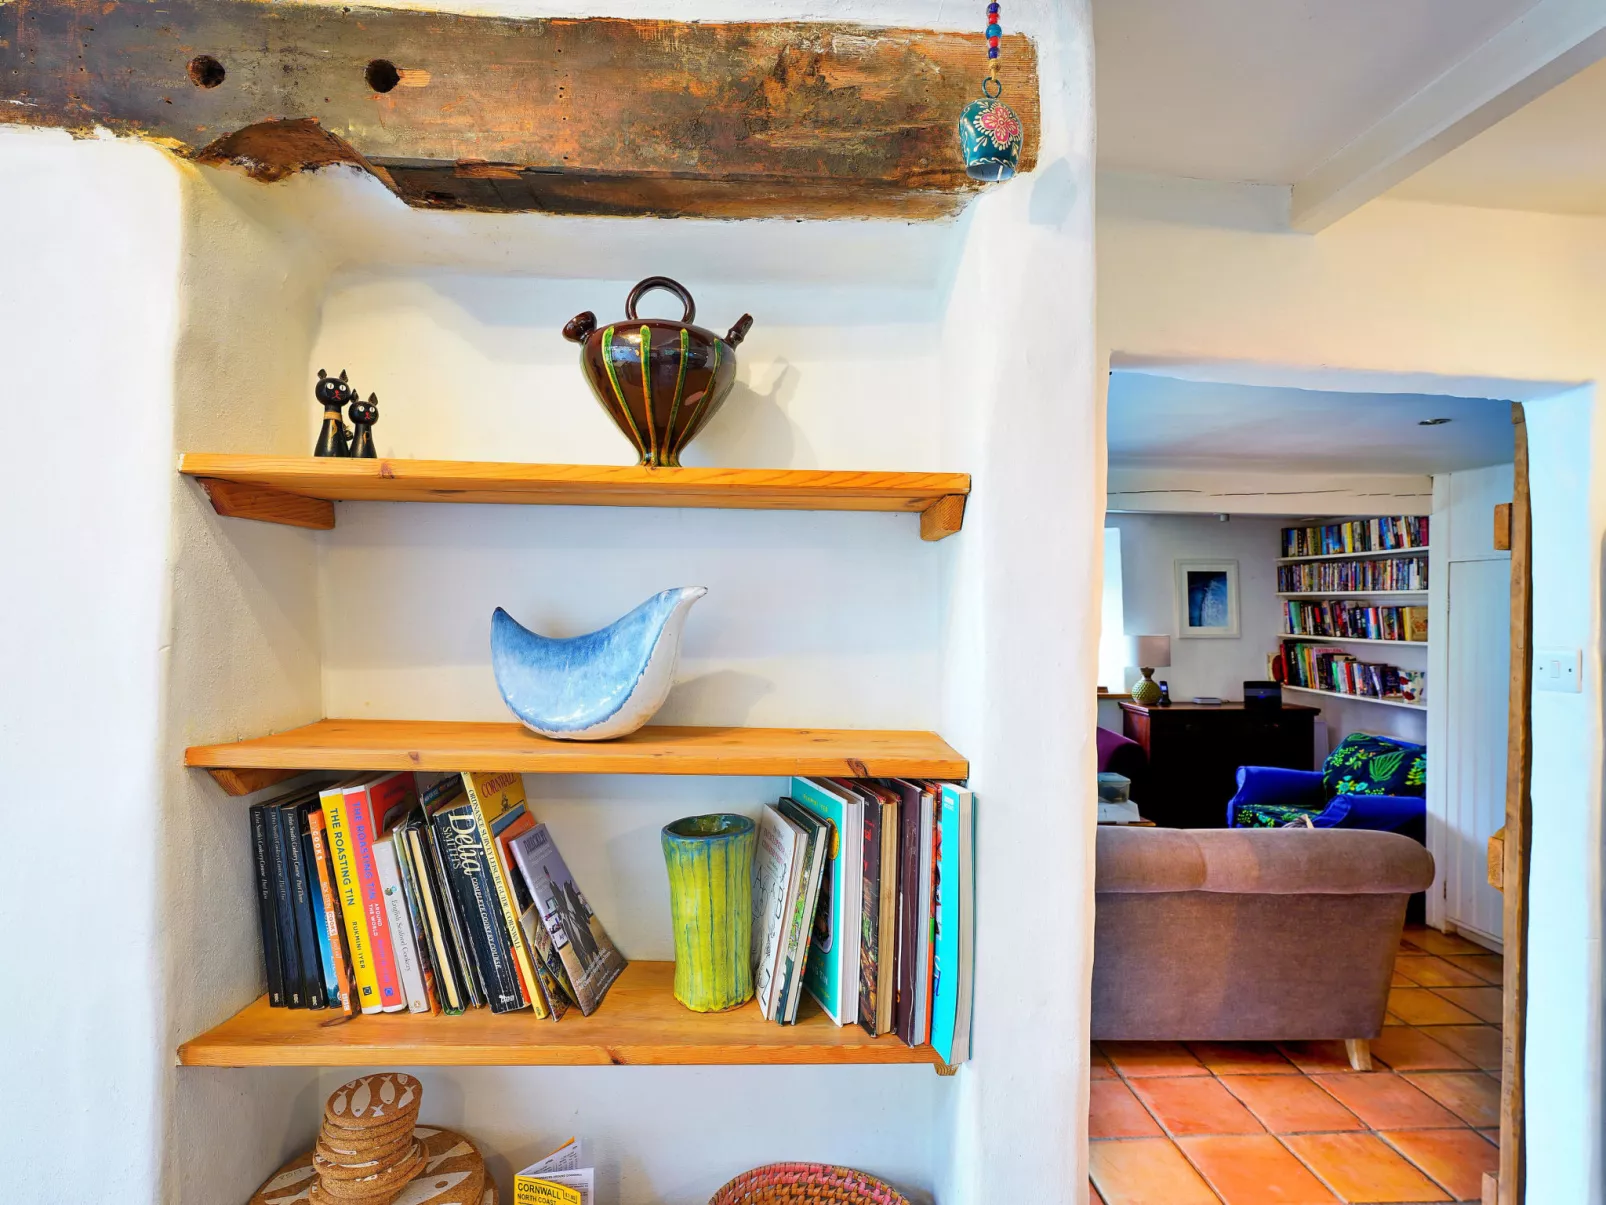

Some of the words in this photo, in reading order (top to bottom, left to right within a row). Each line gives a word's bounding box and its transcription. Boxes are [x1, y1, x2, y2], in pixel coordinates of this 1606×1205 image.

[330, 808, 340, 828] THE
[290, 841, 299, 860] Cookery
[313, 831, 323, 861] COOKS
[334, 832, 351, 885] ROASTING
[352, 802, 362, 821] THE
[357, 825, 373, 879] ROASTING
[366, 883, 376, 900] TIN
[443, 827, 460, 869] SMITH'S
[448, 813, 484, 876] Delia
[469, 790, 484, 829] ORDNANCE
[481, 829, 493, 857] SURVEY
[490, 857, 503, 885] LEISURE
[498, 885, 509, 909] GUIDE
[506, 911, 521, 949] CORNWALL
[344, 888, 355, 906] TIN
[328, 912, 336, 935] COOKS
[391, 899, 401, 922] English
[397, 922, 407, 946] Seafood
[402, 946, 411, 972] Cookery
[472, 877, 486, 911] COMPLETE
[482, 912, 494, 943] COOKERY
[490, 943, 502, 969] COURSE
[352, 921, 362, 952] RUKMINI
[358, 952, 366, 969] IYER
[517, 1182, 561, 1200] CORNWALL
[517, 1193, 537, 1202] NORTH
[538, 1196, 557, 1205] COAST
